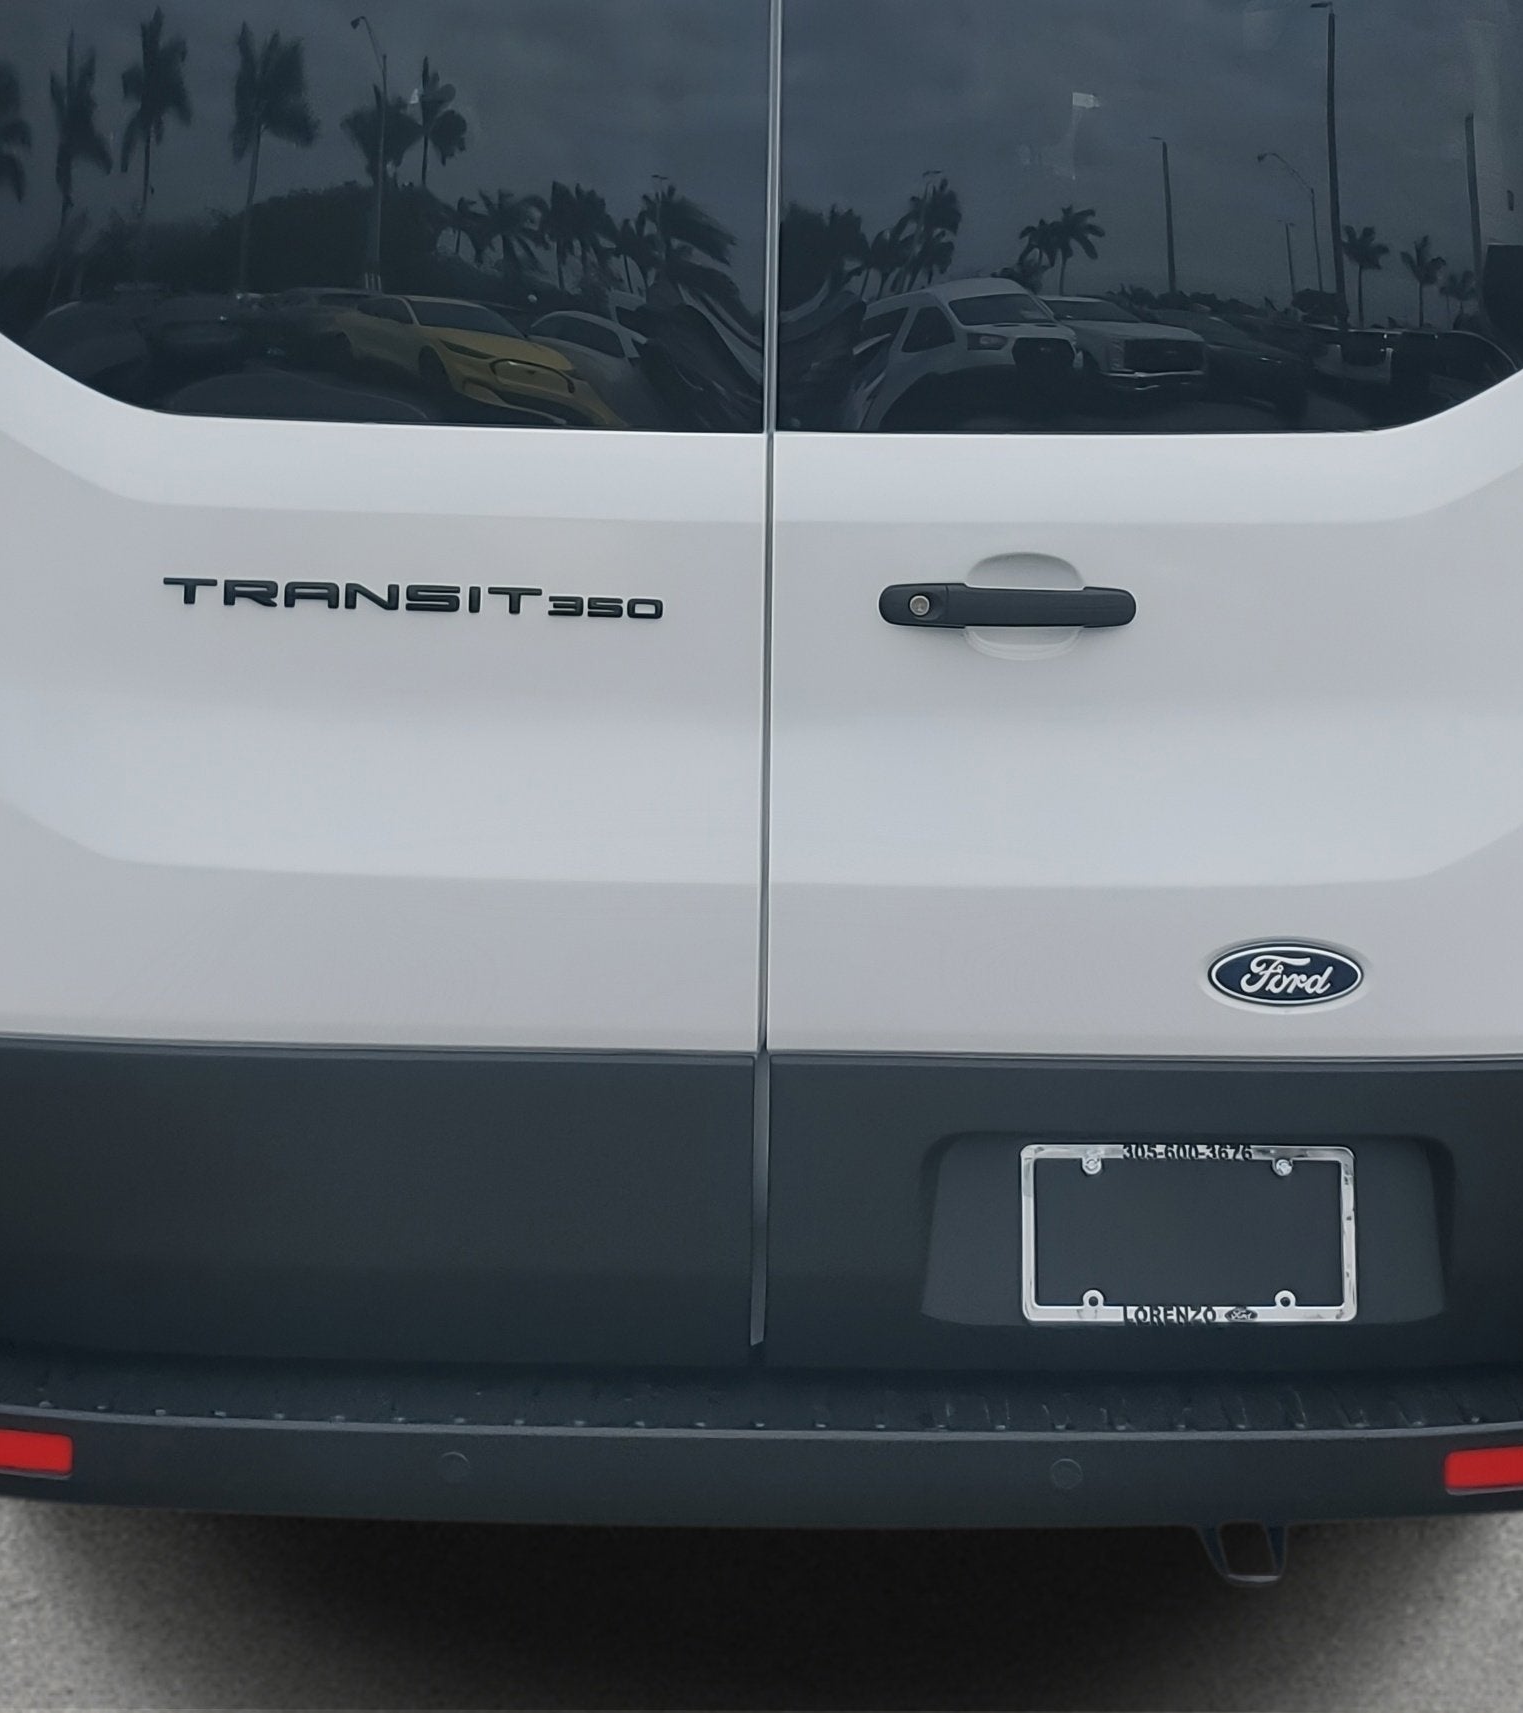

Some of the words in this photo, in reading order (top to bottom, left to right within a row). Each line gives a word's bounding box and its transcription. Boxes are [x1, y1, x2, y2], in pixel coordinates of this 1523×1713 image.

[1240, 954, 1334, 994] Ford
[1122, 1143, 1253, 1161] 305-600-3676
[1123, 1306, 1217, 1323] LORENZO
